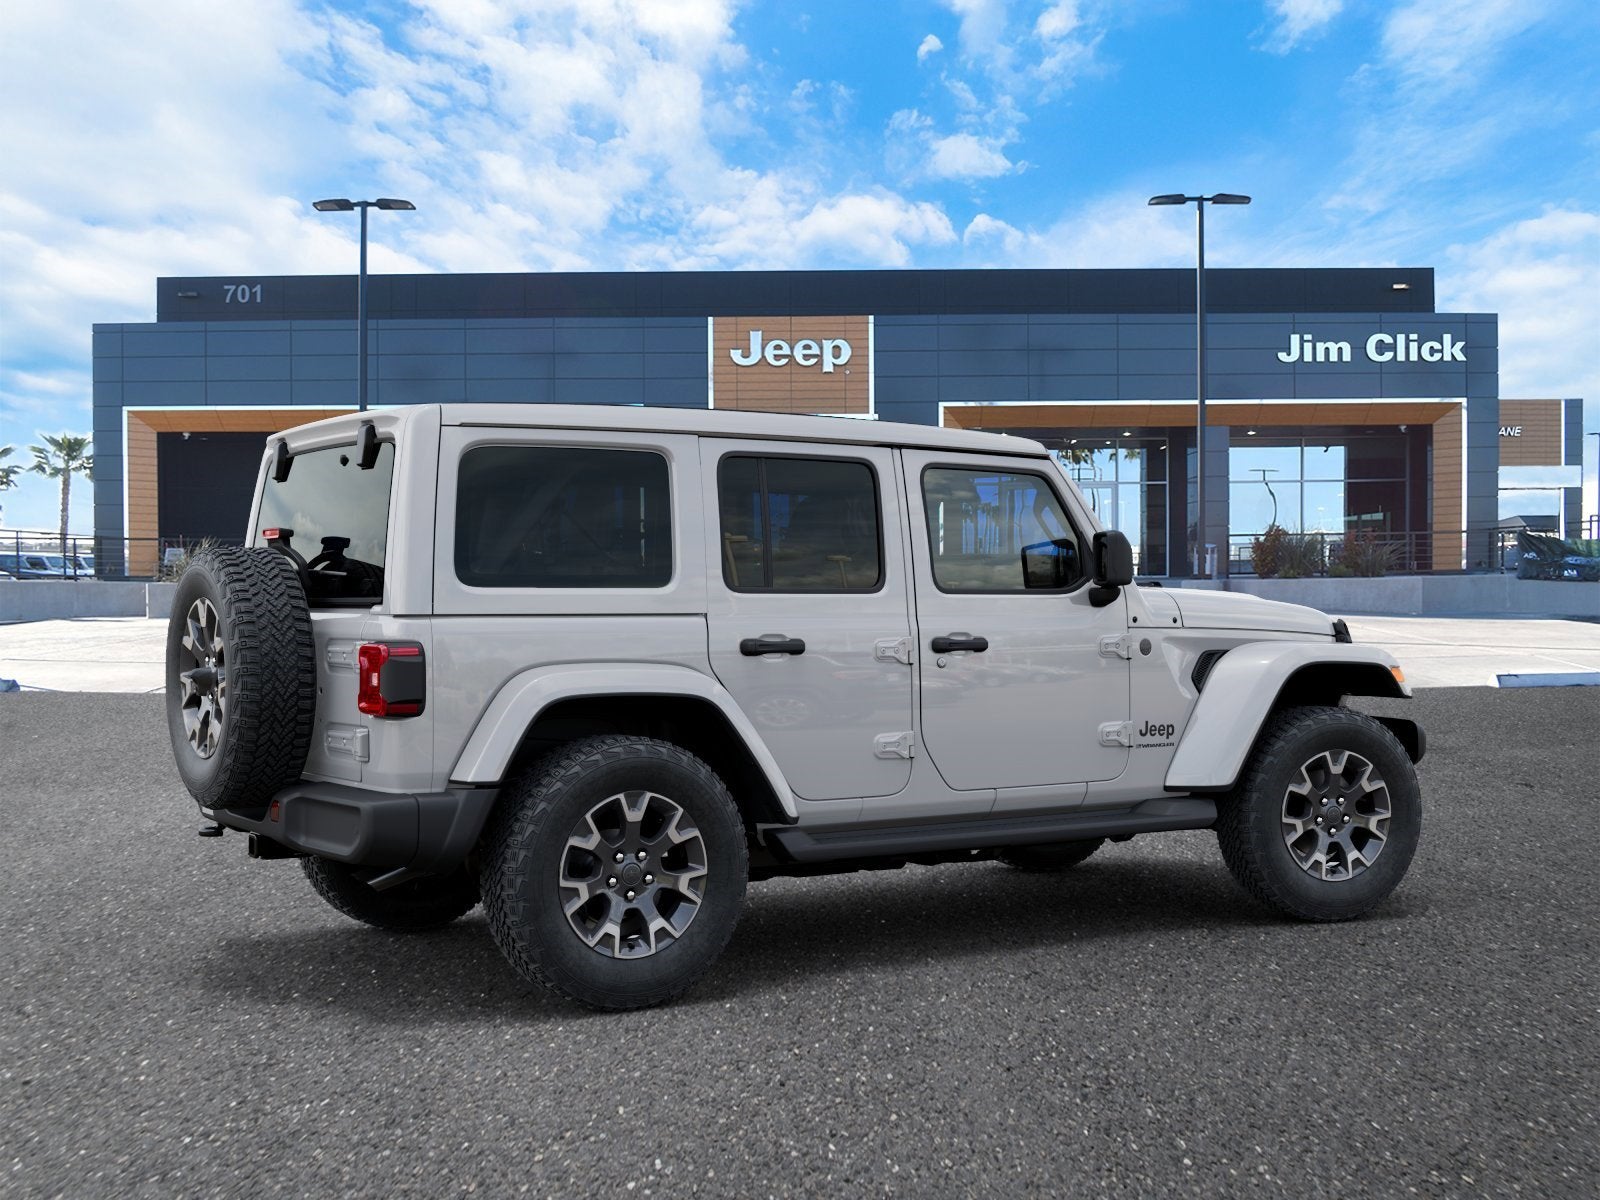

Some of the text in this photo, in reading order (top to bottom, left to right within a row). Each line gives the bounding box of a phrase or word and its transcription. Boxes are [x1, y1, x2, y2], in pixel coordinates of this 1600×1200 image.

[223, 284, 262, 304] 701
[729, 330, 852, 373] Jeep
[1277, 333, 1467, 363] Jim Click
[1139, 720, 1175, 739] Jeep
